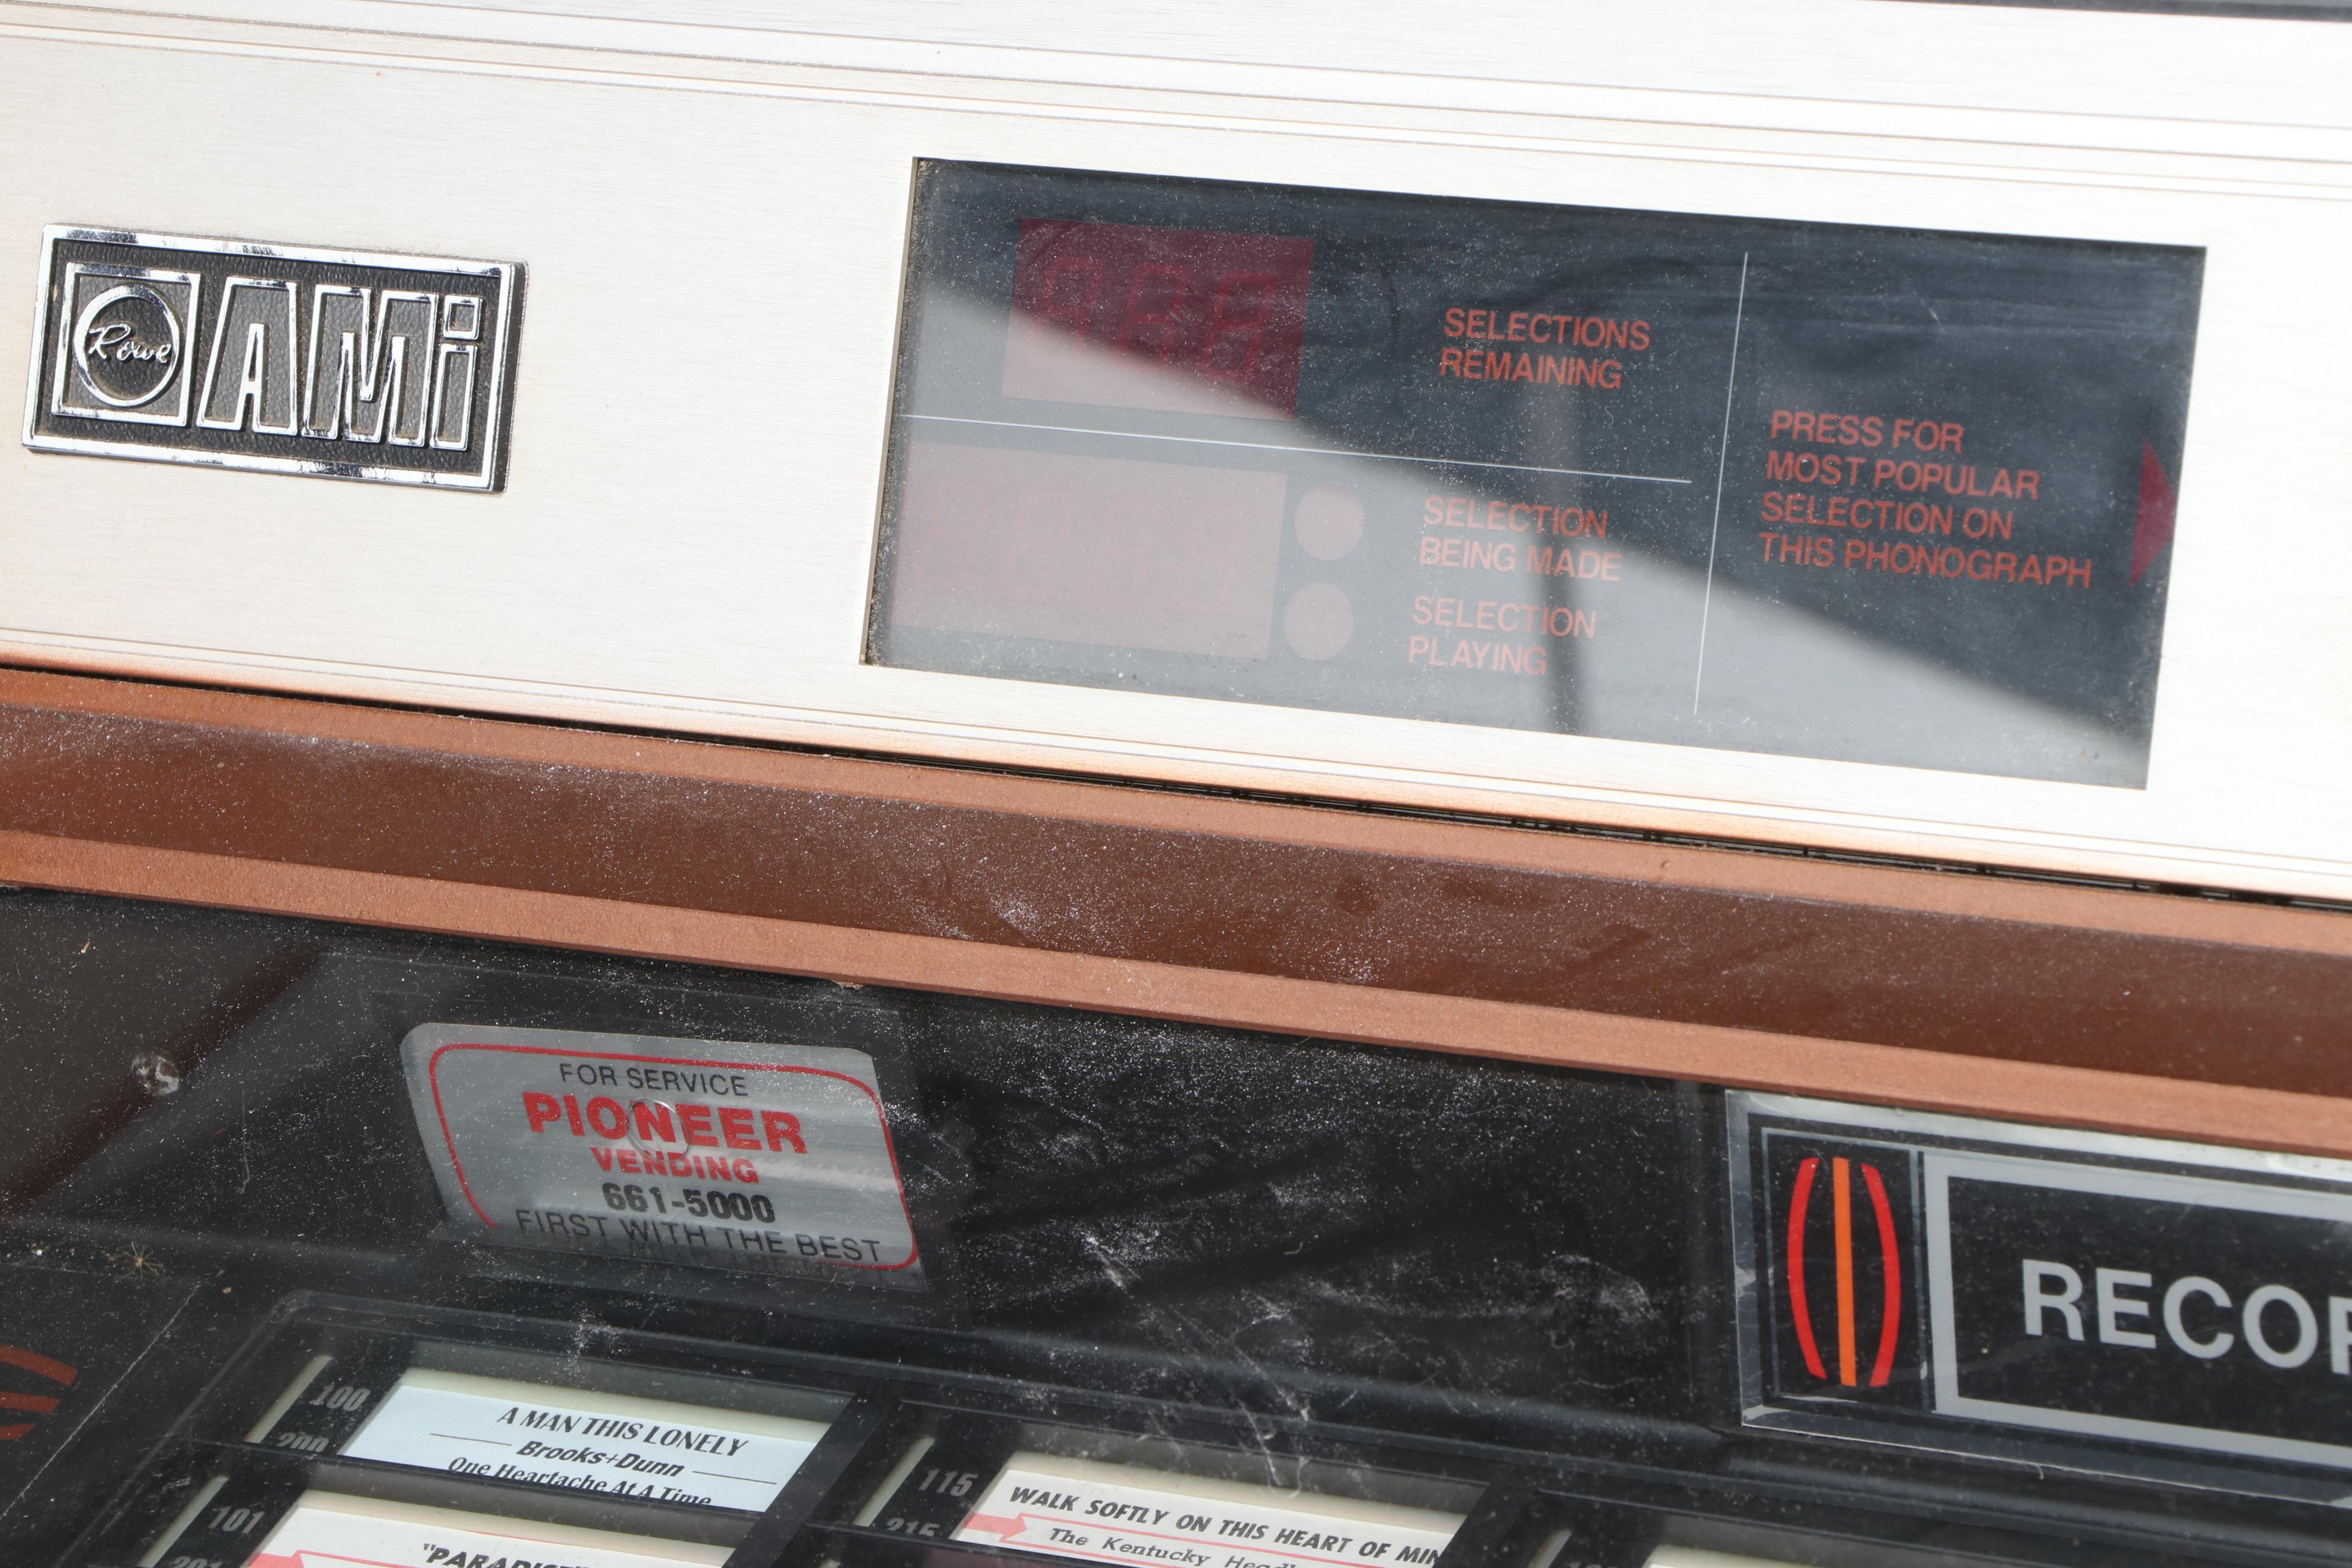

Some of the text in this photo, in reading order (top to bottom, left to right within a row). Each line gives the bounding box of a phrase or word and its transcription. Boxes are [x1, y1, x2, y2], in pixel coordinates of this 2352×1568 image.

[87, 324, 171, 364] Rowe
[1443, 307, 1652, 351] SELECTIONS
[1439, 348, 1623, 390] REMAINING
[1771, 410, 1965, 453] PRESS FOR
[1766, 450, 2040, 501] MOST POPULAR
[1424, 496, 1608, 538] SELECTION
[1760, 492, 2013, 540] SELECTION ON
[1419, 537, 1622, 582] BEING MADE
[1759, 533, 2092, 588] THIS PHONOGRAPH
[1412, 595, 1596, 639] SELECTION
[1408, 636, 1548, 675] PLAYING
[559, 1063, 749, 1097] FOR SERVICE
[522, 1092, 808, 1155] PIONEER
[590, 1147, 760, 1184] VENDING
[601, 1182, 776, 1224] 661-5000
[517, 1211, 881, 1263] FIRST WITH THE BEST
[313, 1383, 371, 1412] 100
[497, 1407, 749, 1456] A MAN THIS LONELY
[449, 1457, 491, 1475] One
[637, 1485, 655, 1498] A
[917, 1469, 977, 1498] 115
[207, 1507, 266, 1534] 101
[1008, 1486, 1081, 1511] WALK
[1084, 1500, 1170, 1525] SOFTLY
[1175, 1514, 1214, 1531] ON
[1217, 1520, 1268, 1541] THIS
[1274, 1528, 1353, 1554] HEART
[1358, 1541, 1392, 1559] OF
[1048, 1527, 1089, 1546] The
[1101, 1537, 1213, 1566] Kentucky
